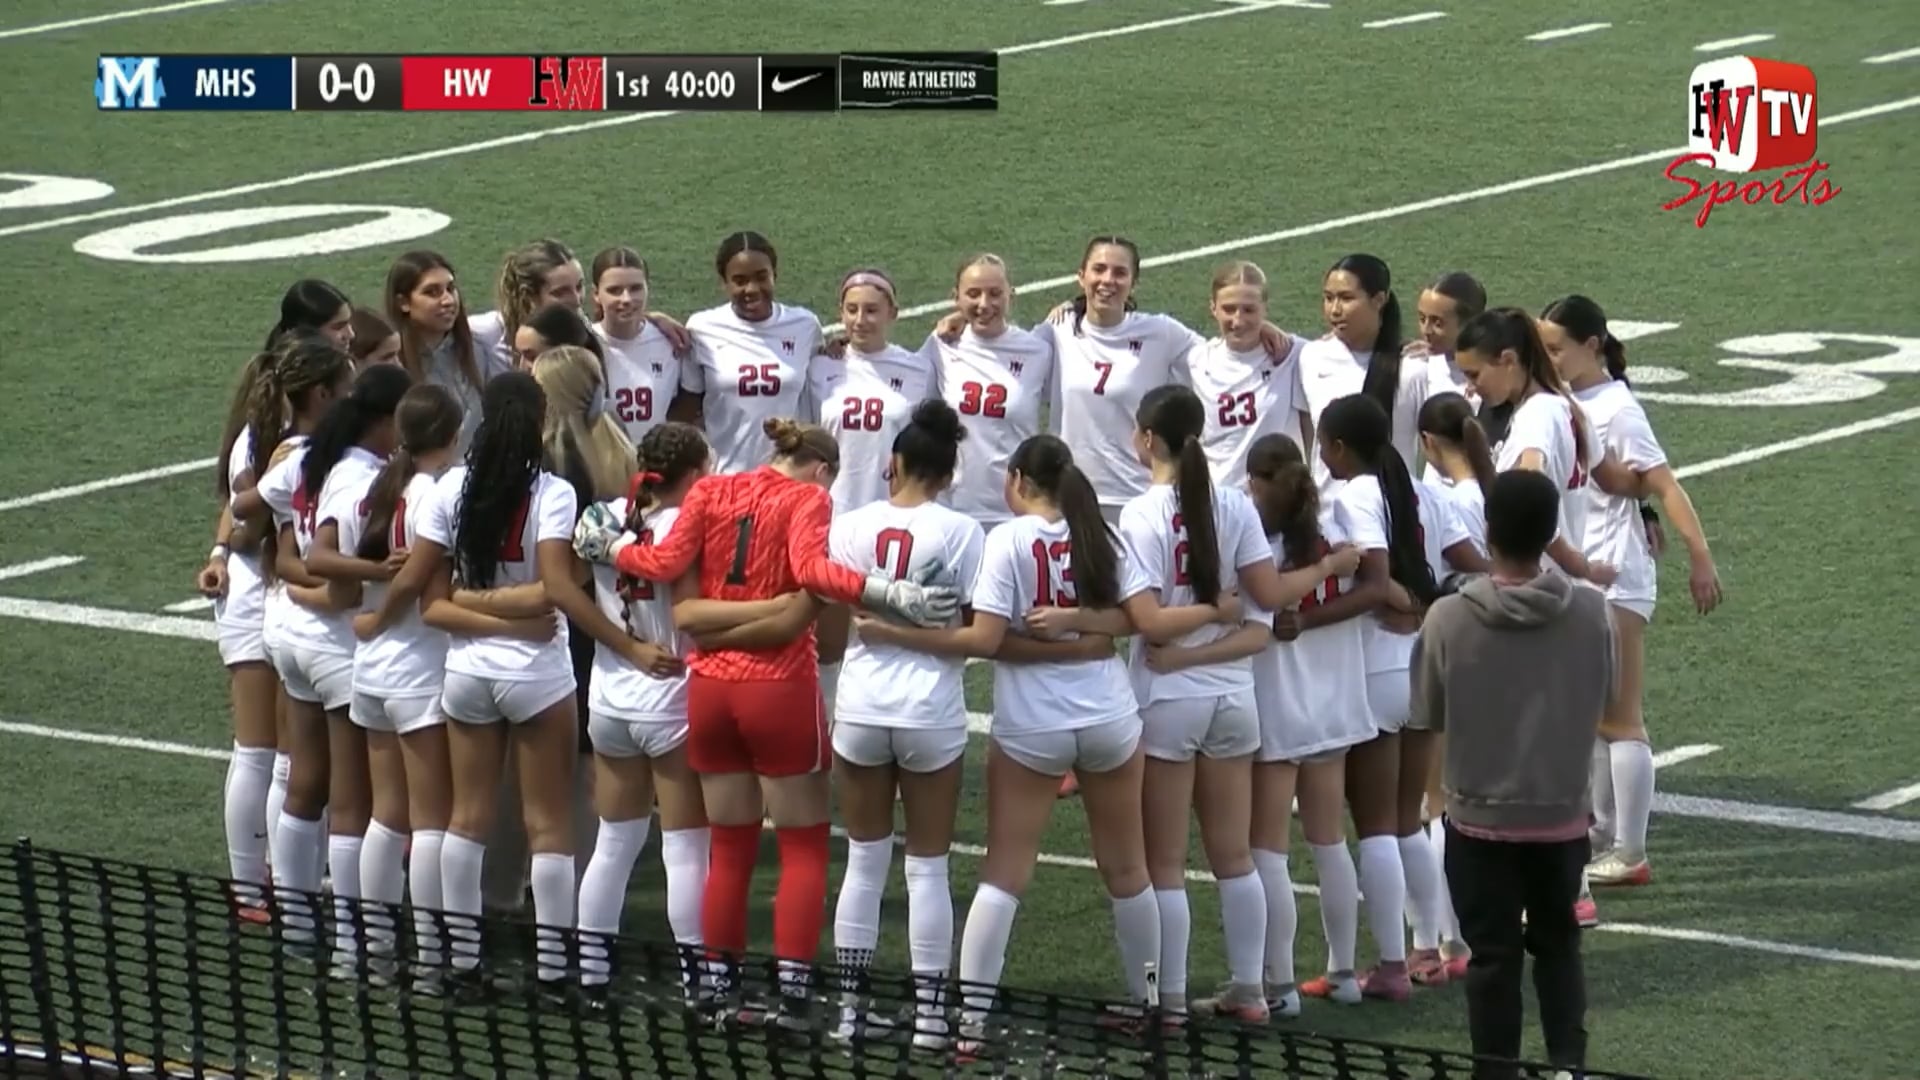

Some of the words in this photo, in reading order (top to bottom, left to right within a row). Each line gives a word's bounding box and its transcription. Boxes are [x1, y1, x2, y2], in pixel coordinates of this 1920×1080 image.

[738, 363, 781, 397] 25
[1094, 361, 1113, 396] 7
[615, 387, 653, 422] 29
[842, 396, 884, 431] 28
[959, 381, 1008, 419] 32
[1217, 391, 1258, 428] 23
[725, 515, 755, 586] 1
